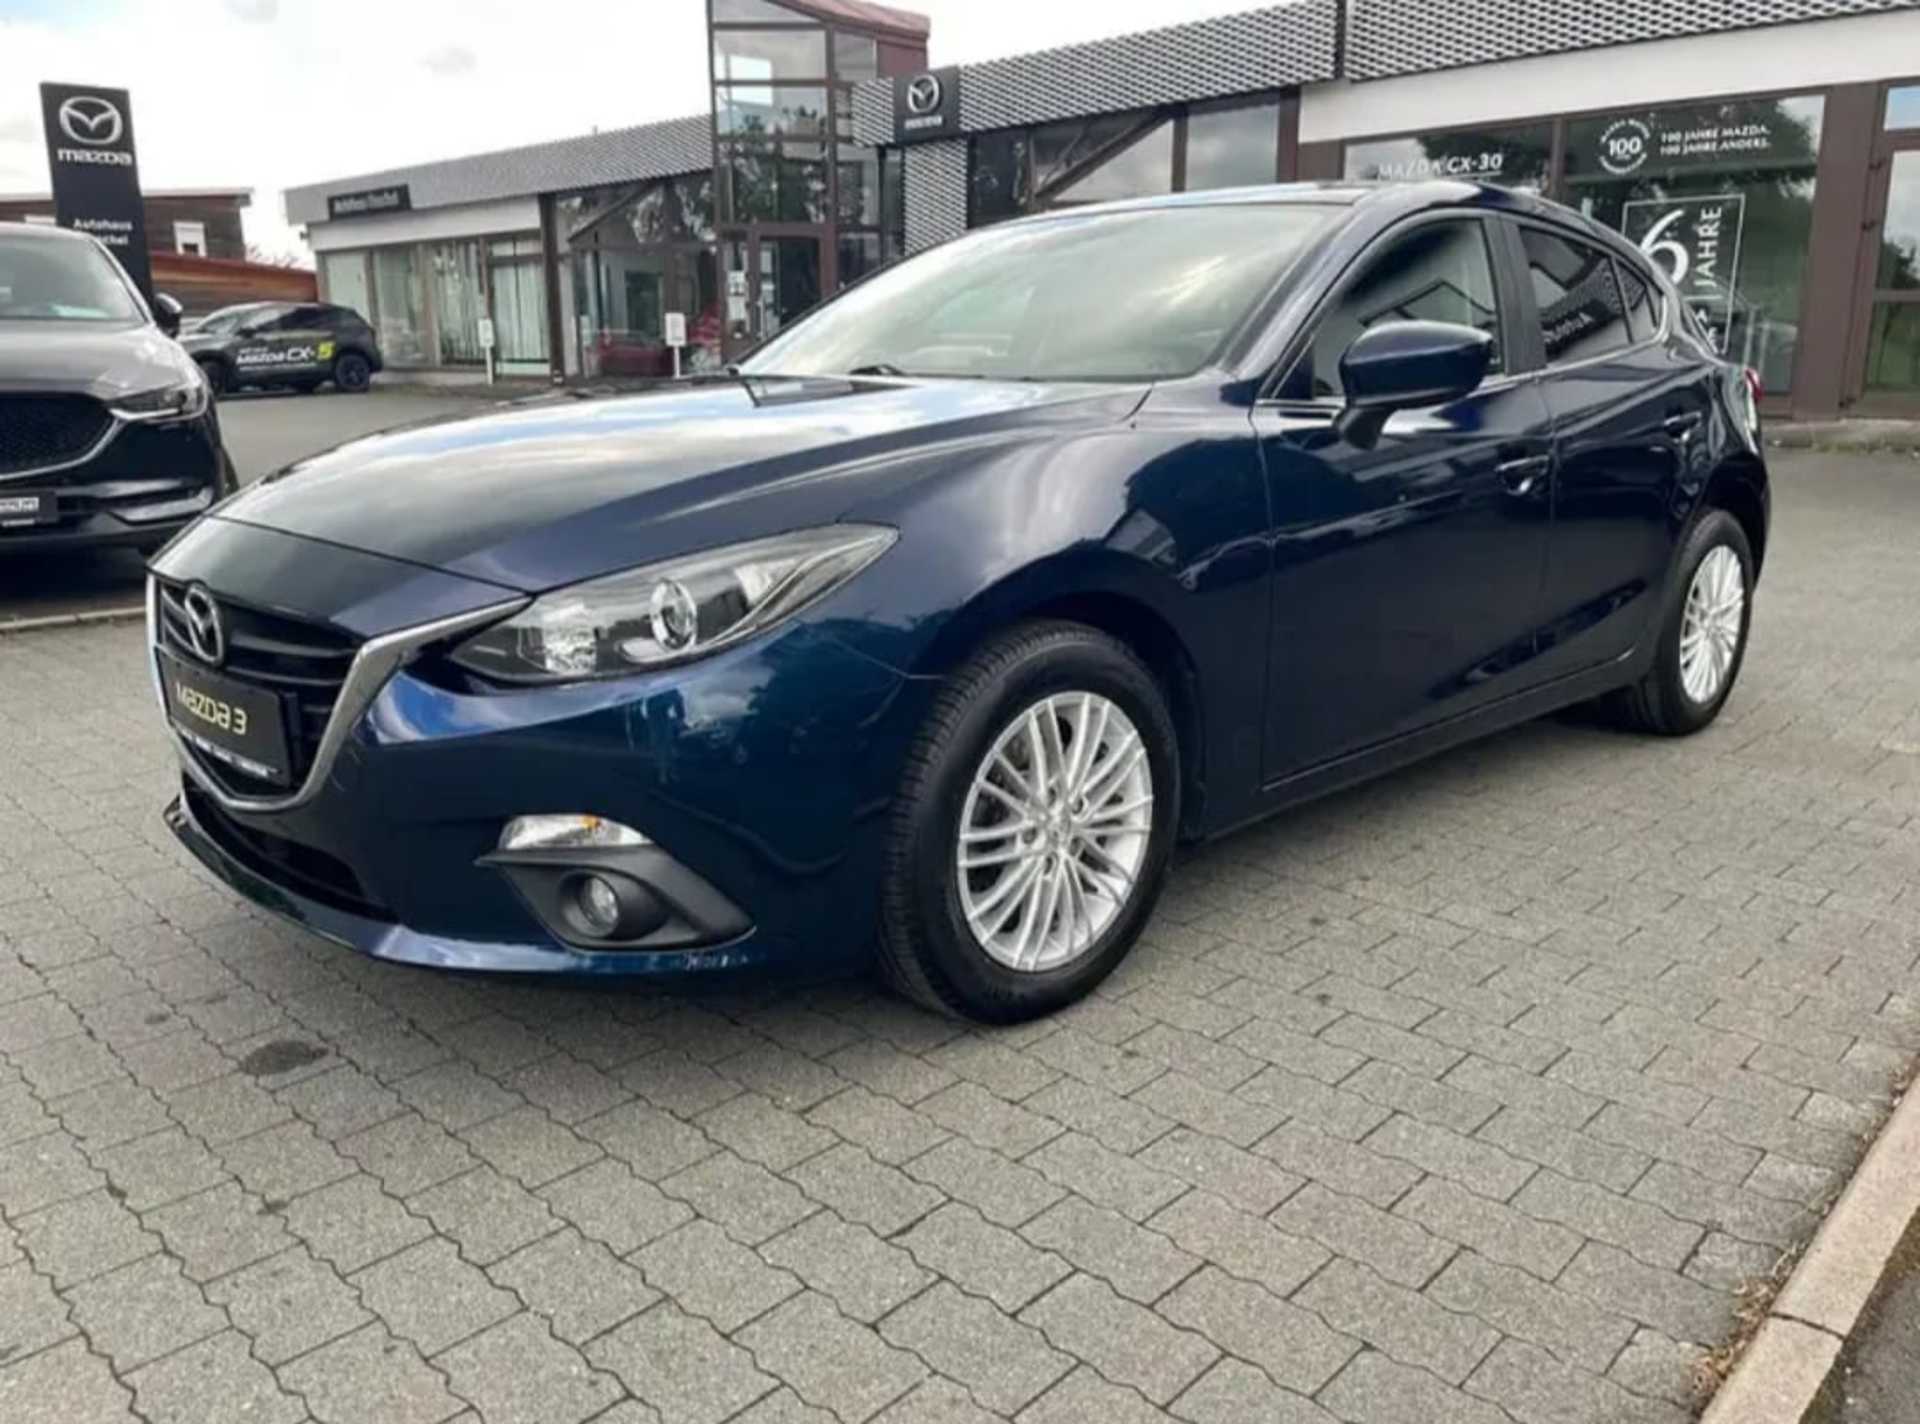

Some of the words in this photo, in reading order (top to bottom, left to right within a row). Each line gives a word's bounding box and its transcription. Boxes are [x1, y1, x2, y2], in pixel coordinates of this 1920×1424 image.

[1609, 136, 1642, 156] 100
[1661, 132, 1681, 143] 100
[1684, 129, 1718, 141] JAHRE
[1682, 141, 1717, 154] JAHRE
[1446, 153, 1502, 173] CX-30
[73, 218, 133, 231] Autohaus
[1694, 206, 1722, 288] JAHRE
[233, 706, 248, 735] 3
